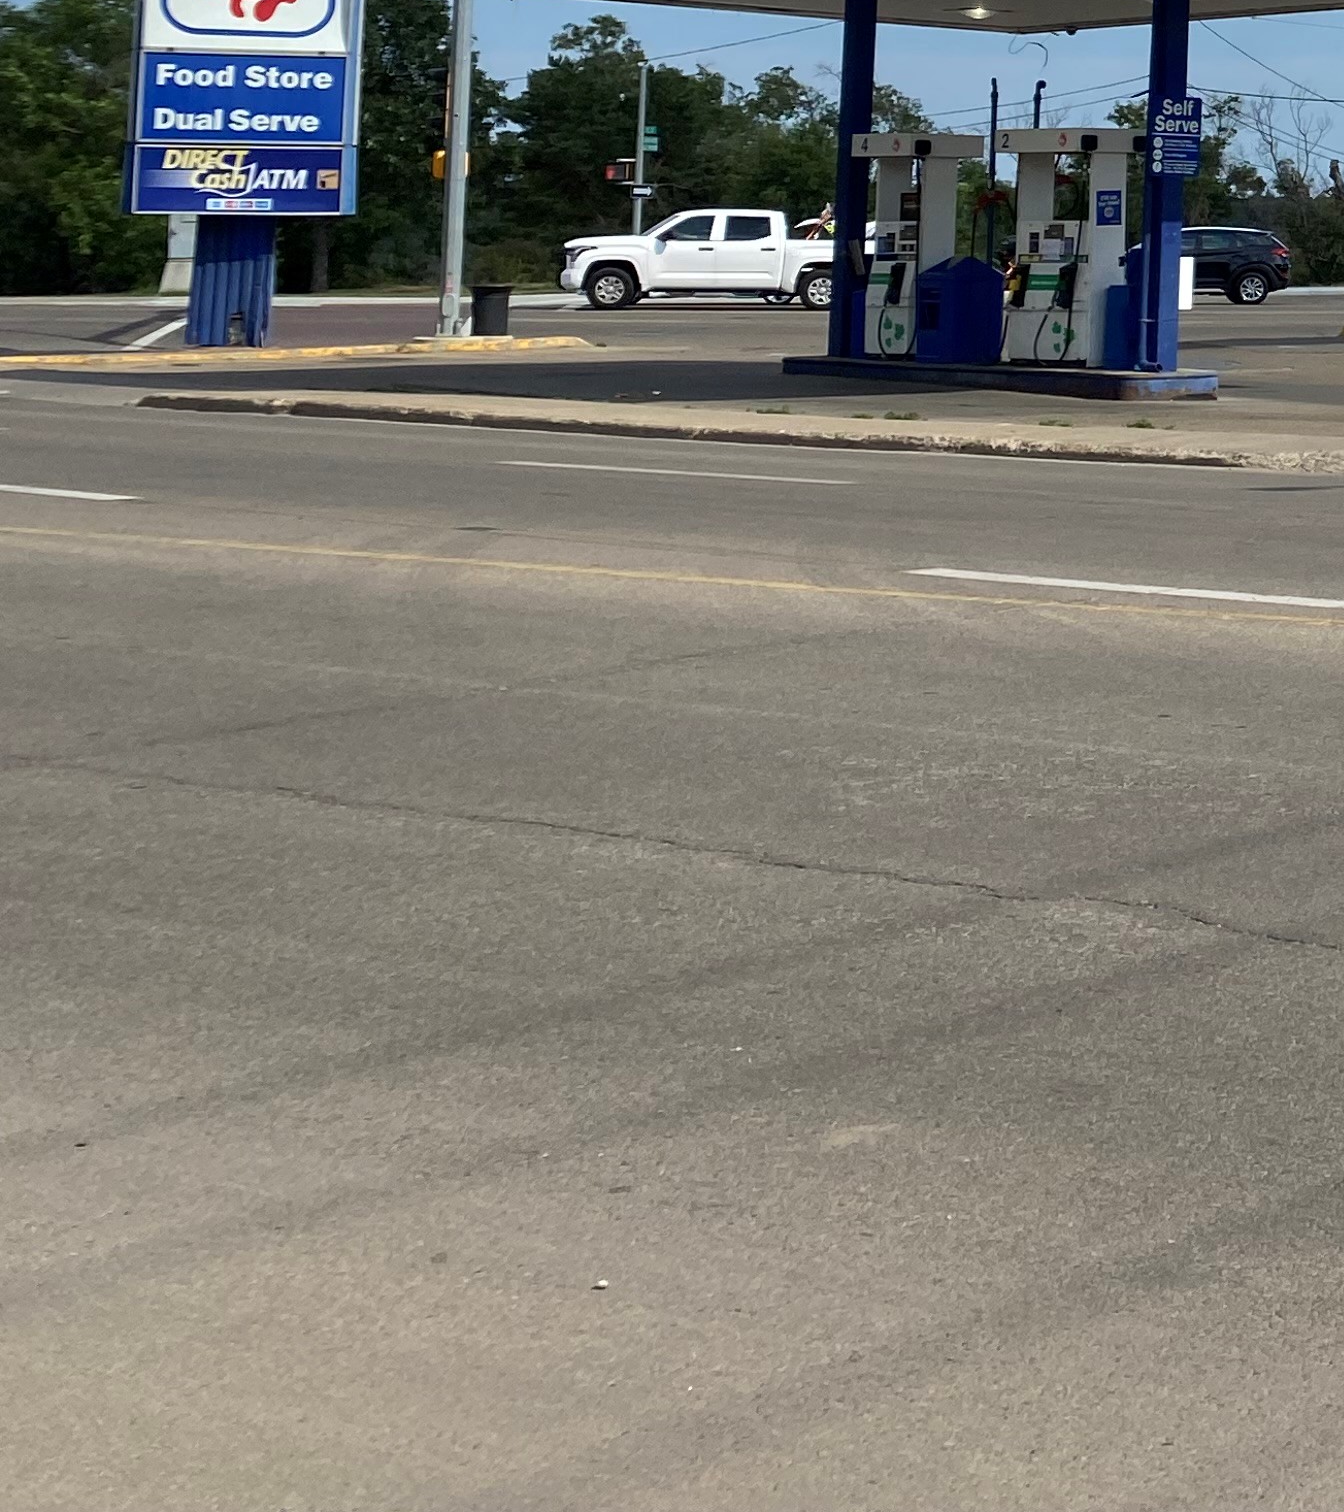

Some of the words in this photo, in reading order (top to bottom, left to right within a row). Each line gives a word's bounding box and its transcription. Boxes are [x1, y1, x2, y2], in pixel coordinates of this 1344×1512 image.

[155, 63, 236, 88] Food
[244, 64, 333, 90] Store
[1162, 98, 1195, 117] Self
[153, 107, 224, 131] Dual
[228, 108, 322, 133] Serve
[1154, 114, 1200, 134] Serve
[860, 137, 869, 153] 4
[1001, 133, 1010, 149] 2
[162, 149, 250, 170] DIRECT
[190, 167, 248, 190] Cash
[252, 169, 309, 190] ATM
